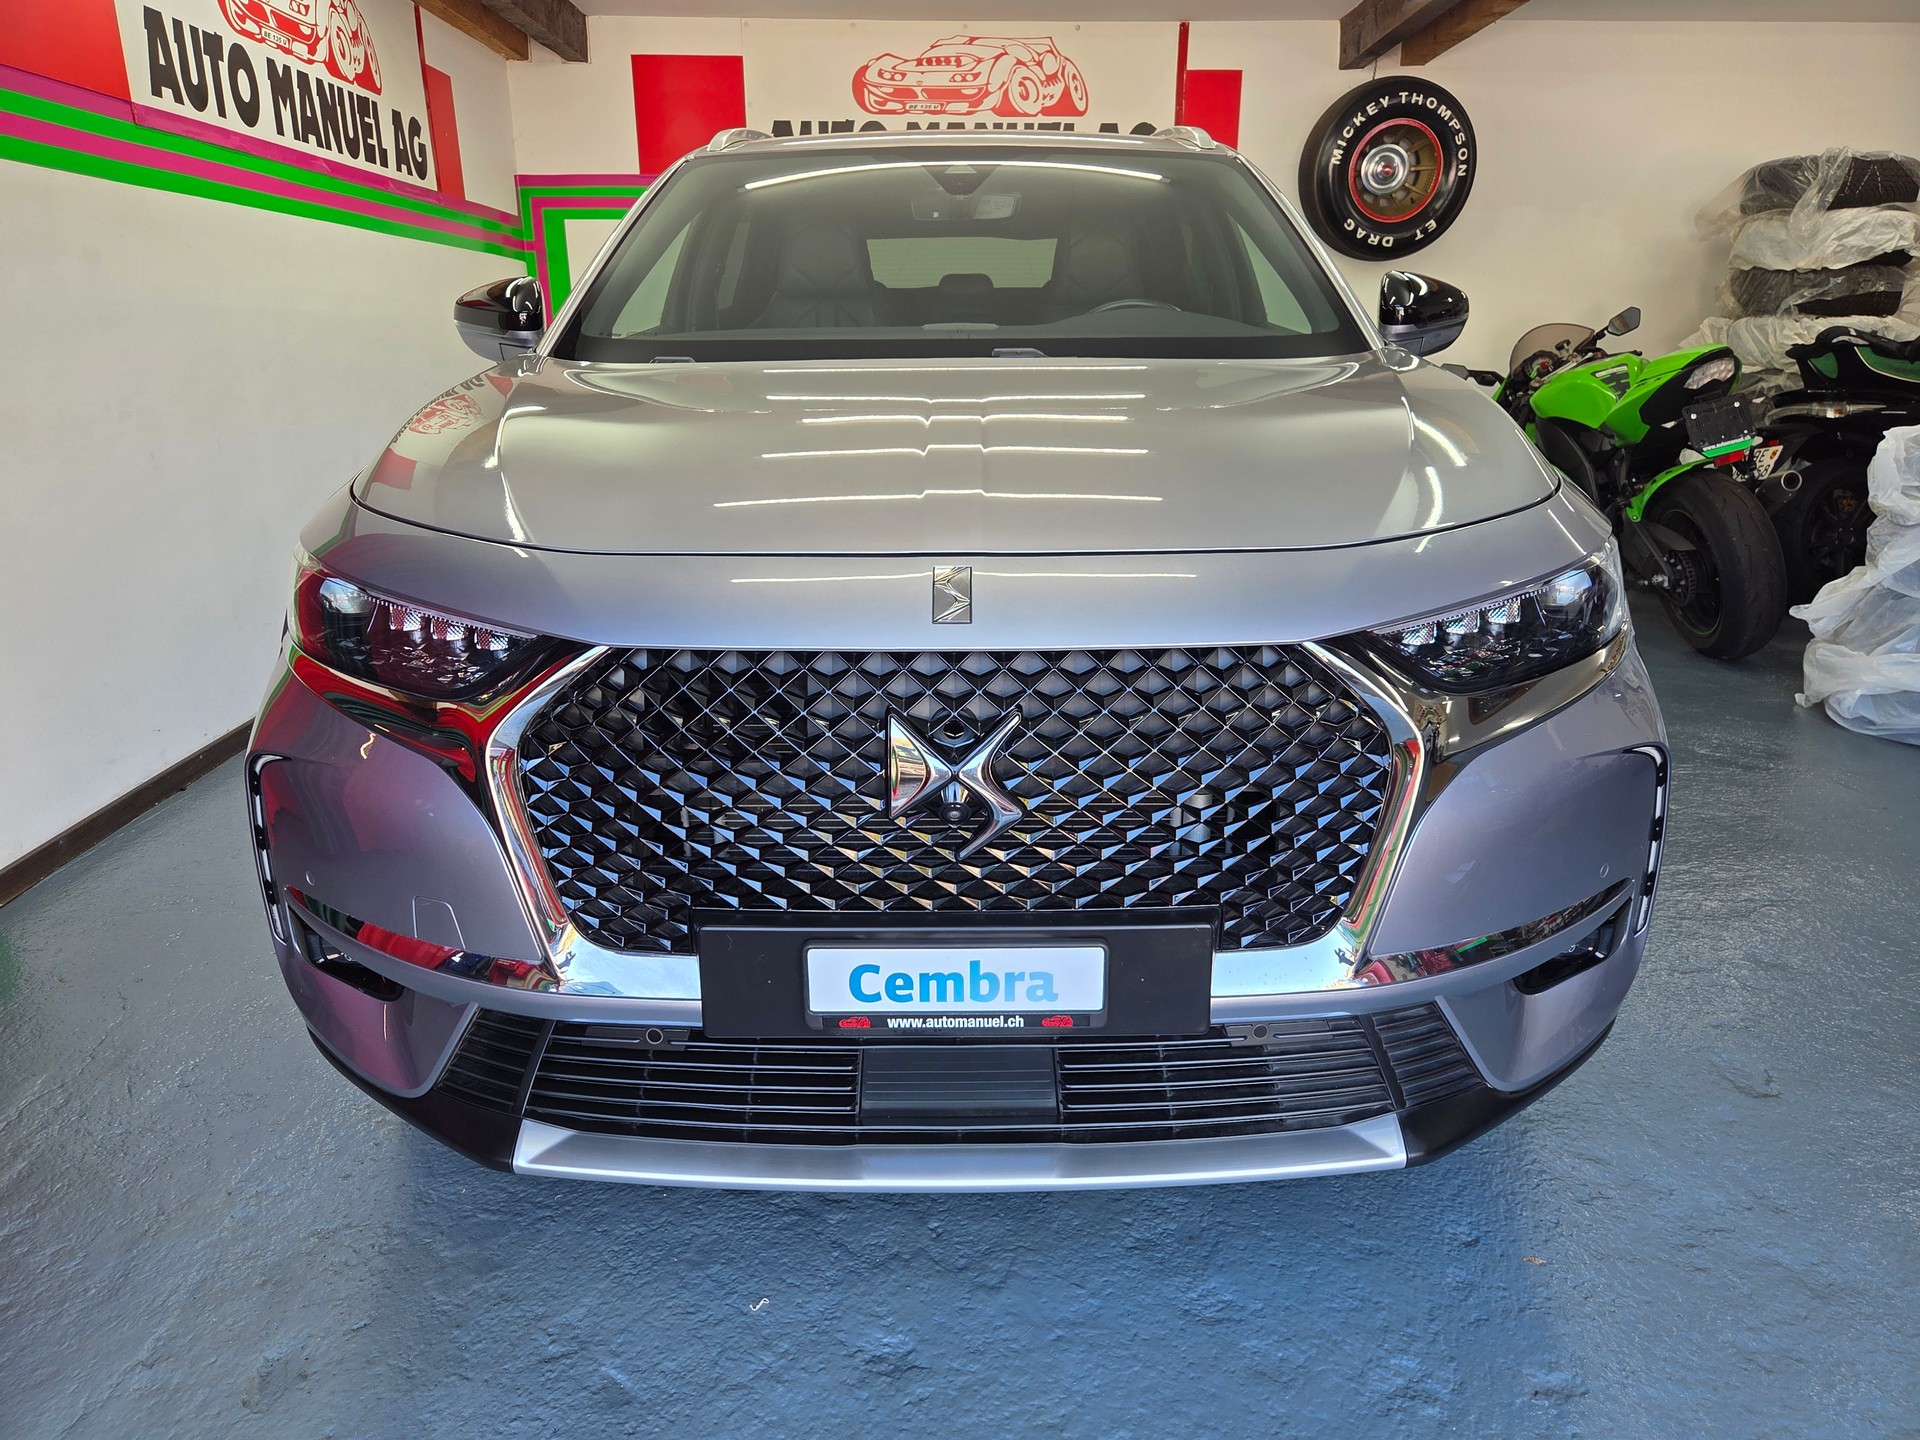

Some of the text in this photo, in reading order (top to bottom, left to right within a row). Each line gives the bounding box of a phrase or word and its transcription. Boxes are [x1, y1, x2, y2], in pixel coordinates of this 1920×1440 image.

[143, 5, 428, 181] AUTO MANUEL AG
[1331, 91, 1468, 177] MICKEY THOMPSON
[1343, 218, 1437, 248] ET DRAG
[849, 960, 1059, 1004] Cembra
[887, 1015, 1025, 1028] www.automanuel.ch
